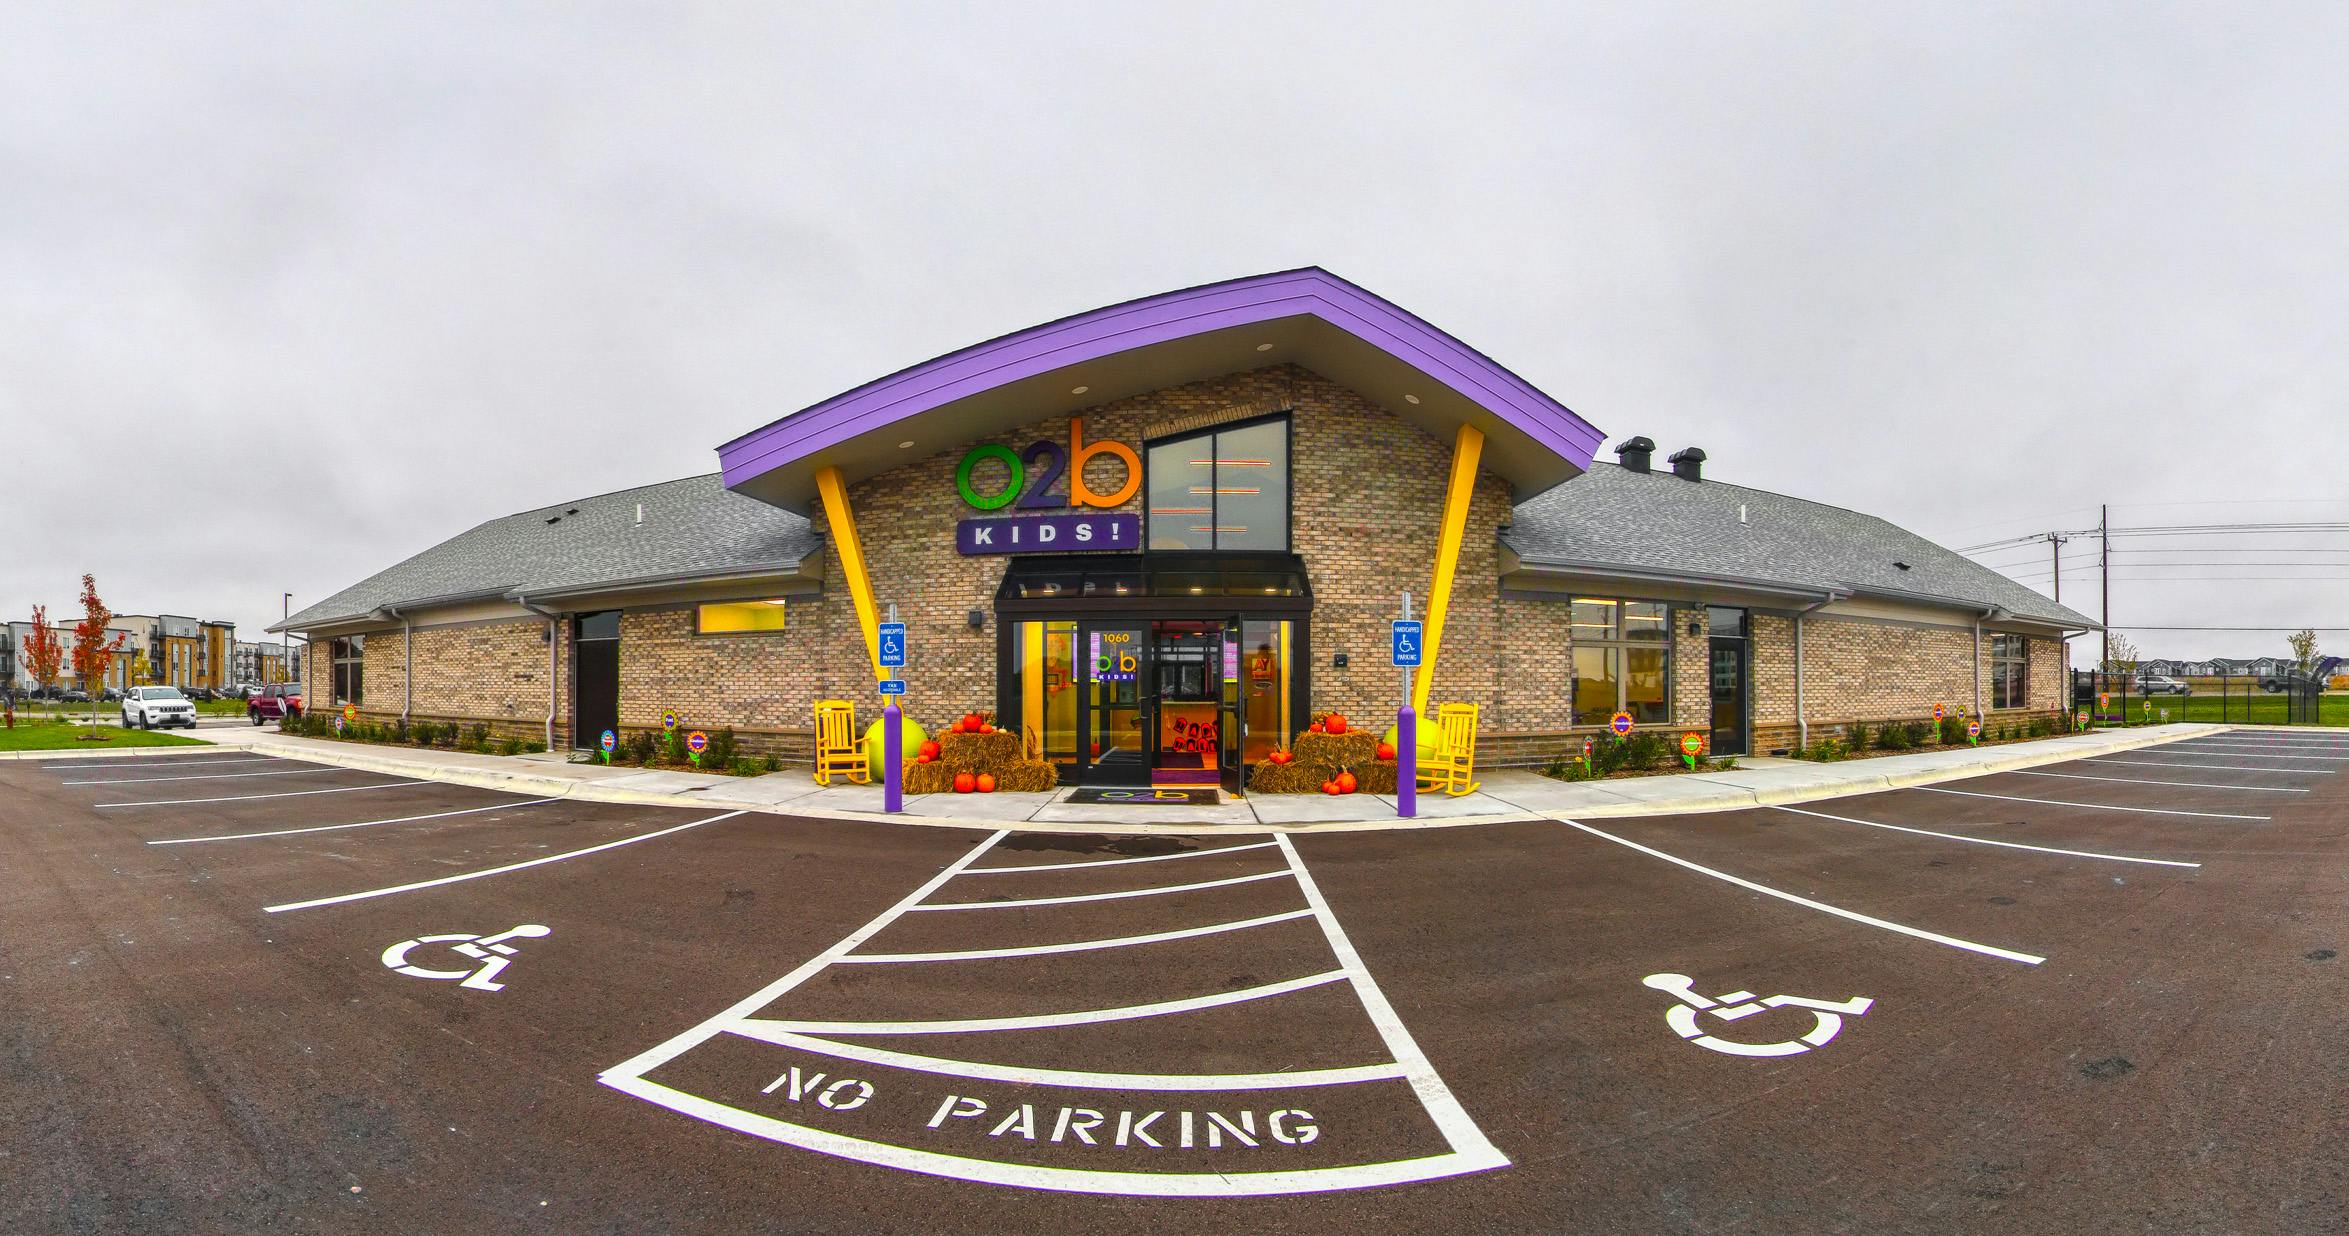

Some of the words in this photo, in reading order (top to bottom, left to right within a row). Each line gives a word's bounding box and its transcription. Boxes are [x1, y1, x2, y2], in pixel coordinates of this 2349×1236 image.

[957, 418, 1142, 510] o2b
[975, 523, 1120, 544] KIDS!
[1103, 633, 1130, 643] 1060
[762, 1066, 875, 1111] NO
[928, 1095, 1320, 1147] PARKING
